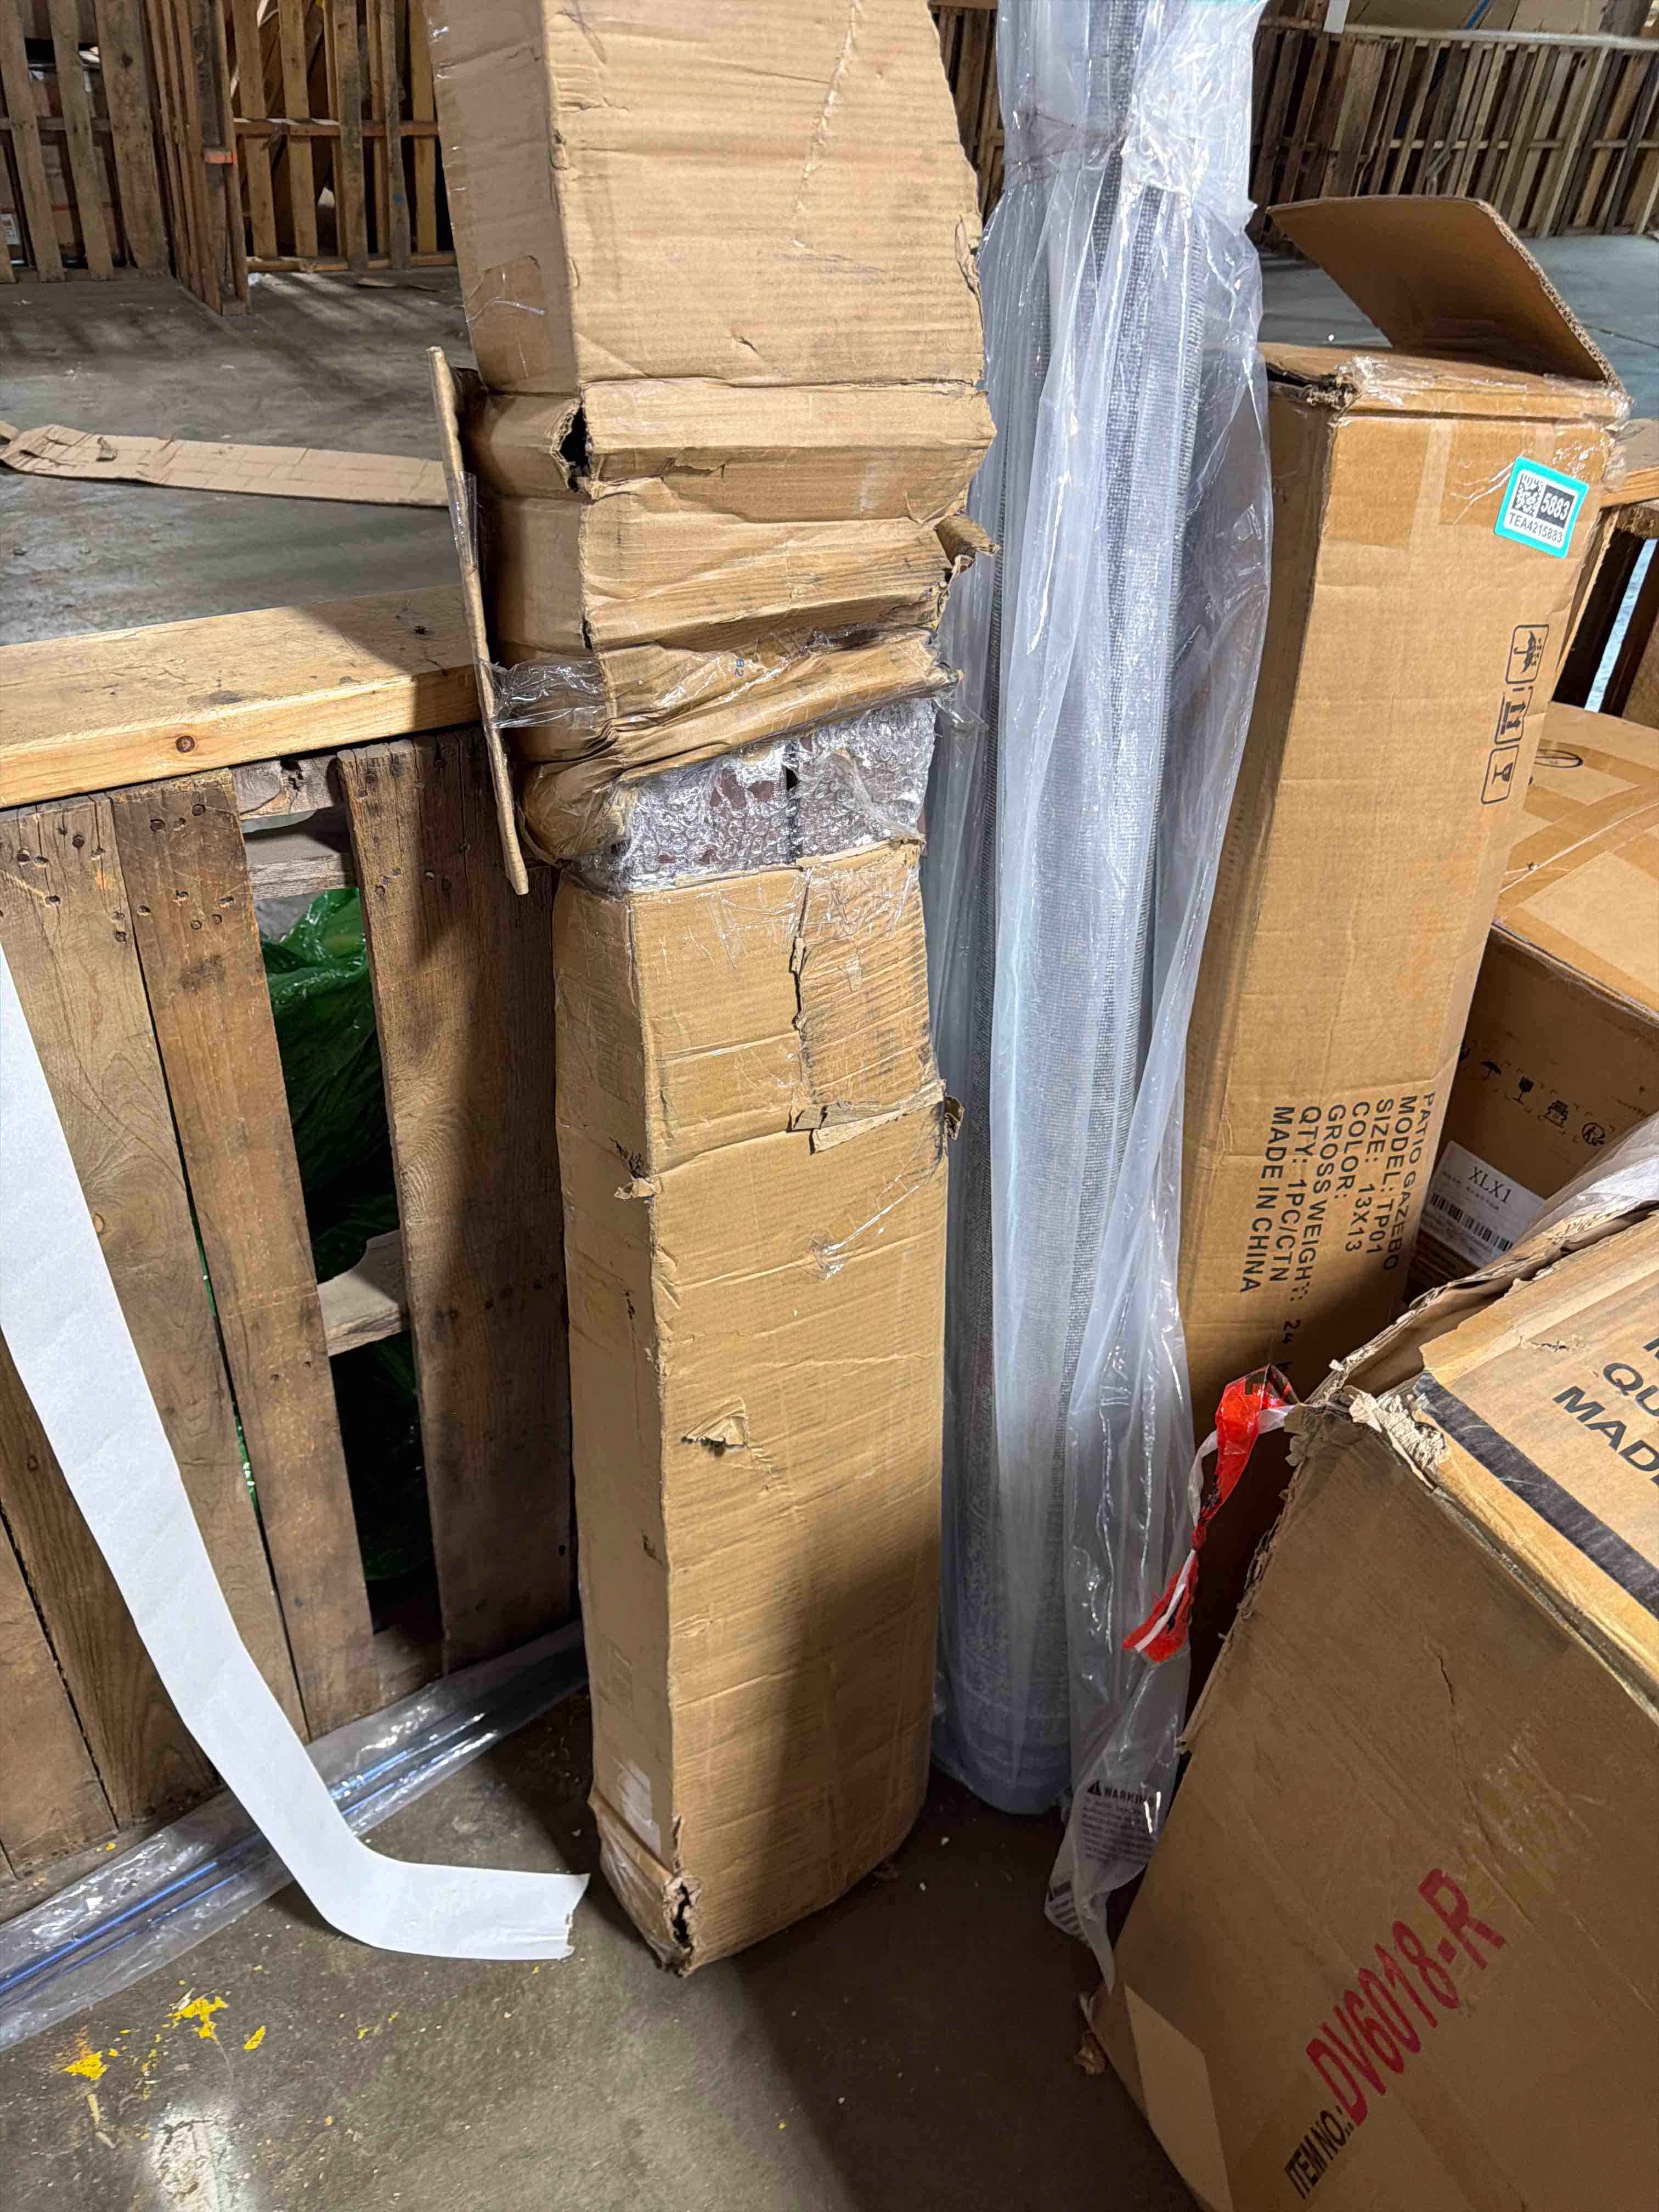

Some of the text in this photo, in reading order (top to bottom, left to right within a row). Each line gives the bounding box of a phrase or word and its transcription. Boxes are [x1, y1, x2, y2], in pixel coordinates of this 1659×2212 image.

[1509, 512, 1563, 544] TEA4215883
[1541, 493, 1571, 521] 5883
[1239, 1106, 1296, 1294] MADE IN CHINA
[1269, 1106, 1322, 1282] QTY: 1PC/CTN
[1313, 1104, 1347, 1194] GROSS
[1334, 1102, 1370, 1200] COLOR:
[1345, 1098, 1394, 1252] SIZE: 13X13
[1365, 1096, 1418, 1254] MODEL: TP01
[1383, 1092, 1435, 1271] PATIO GAZEBO
[1552, 1386, 1659, 1488] MAD
[1284, 2134, 1328, 2200] ITEM
[1306, 1868, 1506, 2126] DV6018-R
